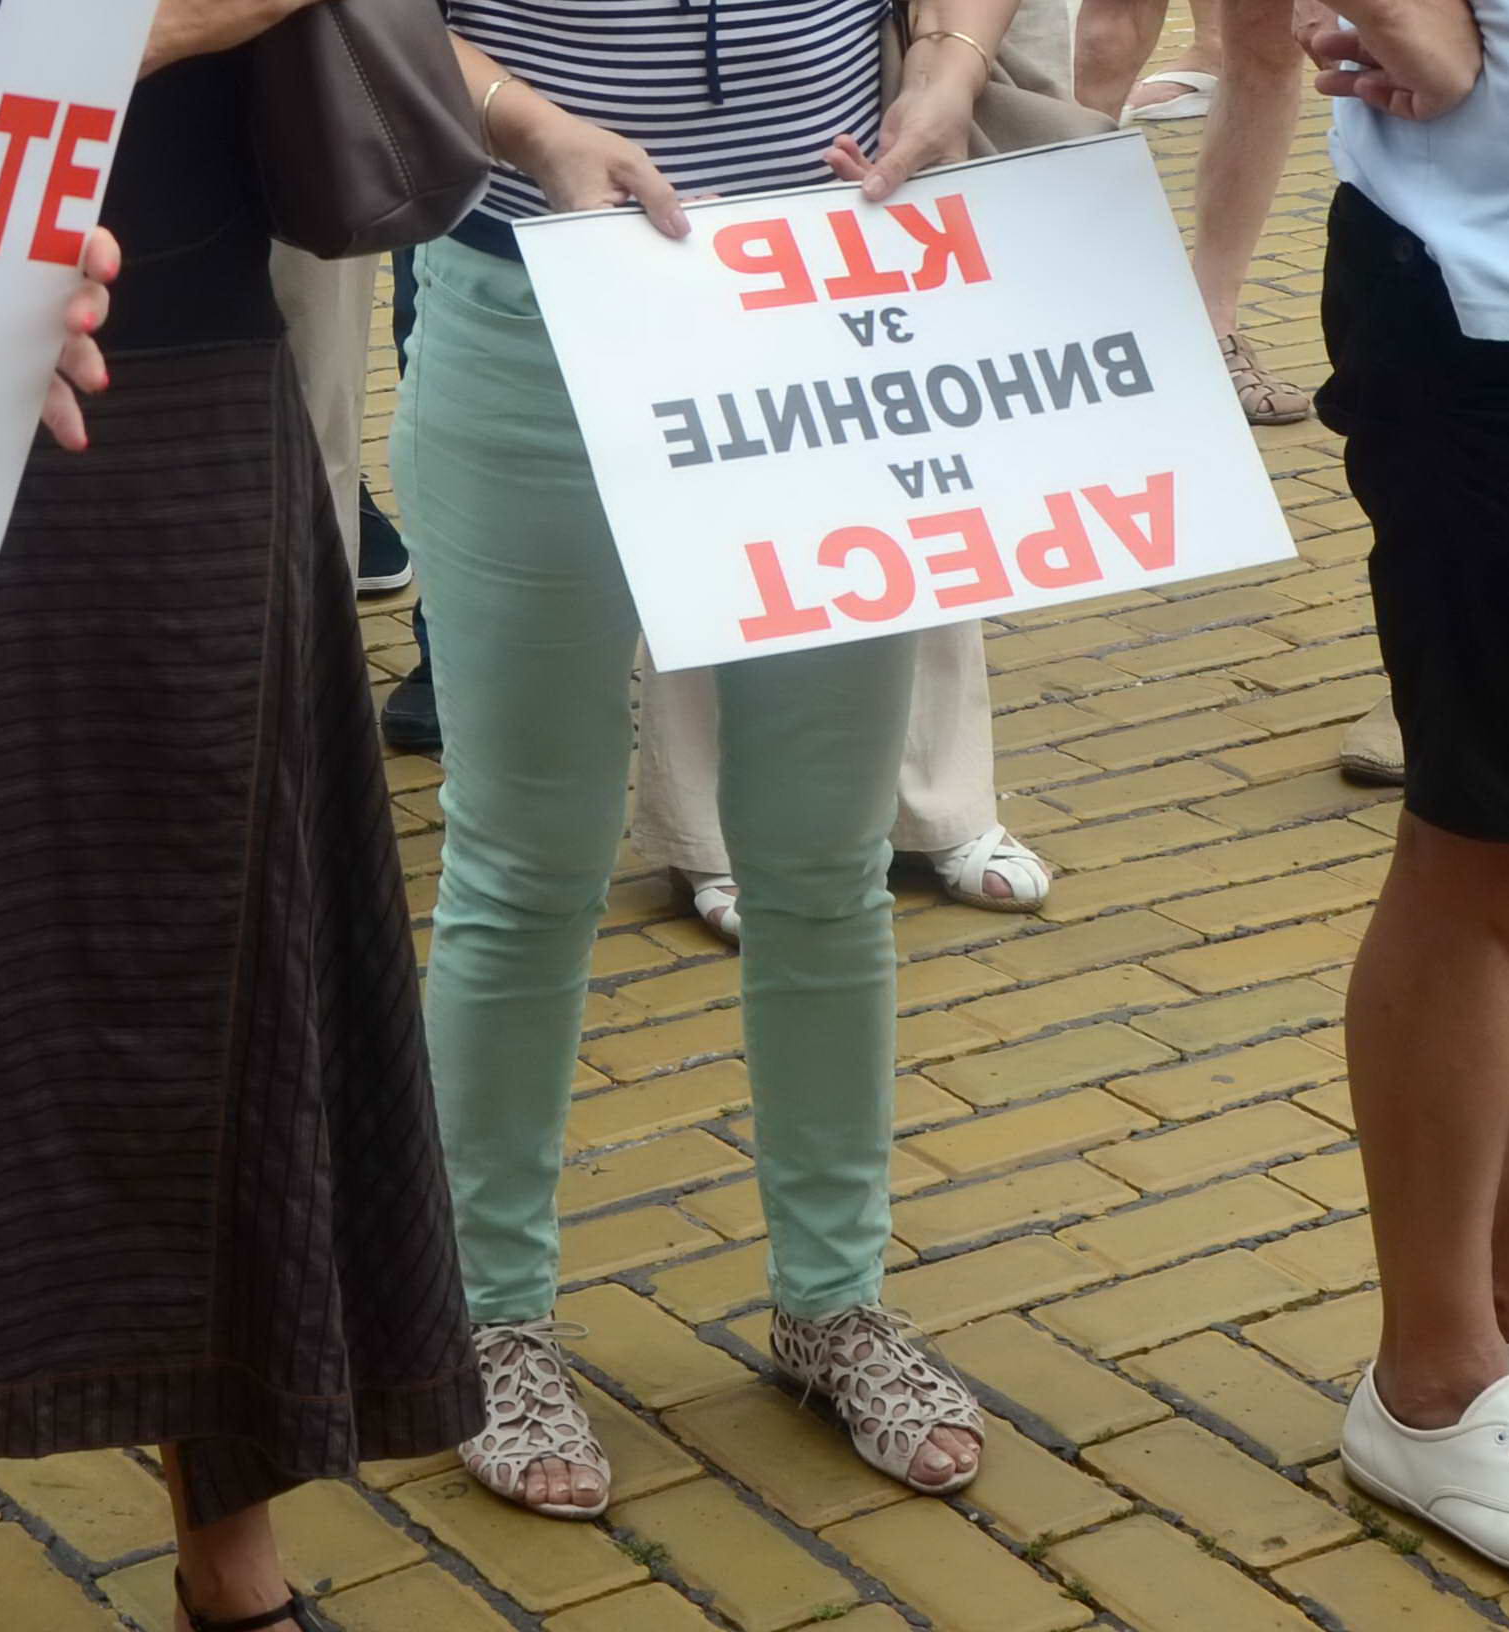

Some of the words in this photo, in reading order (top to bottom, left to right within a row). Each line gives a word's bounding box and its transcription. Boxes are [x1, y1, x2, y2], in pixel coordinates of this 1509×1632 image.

[711, 193, 993, 312] КТБ
[839, 306, 915, 348] ЗА
[651, 330, 1155, 469] ВИНОВНИТЕ
[887, 454, 974, 500] НА
[738, 470, 1177, 644] АРЕСТ
